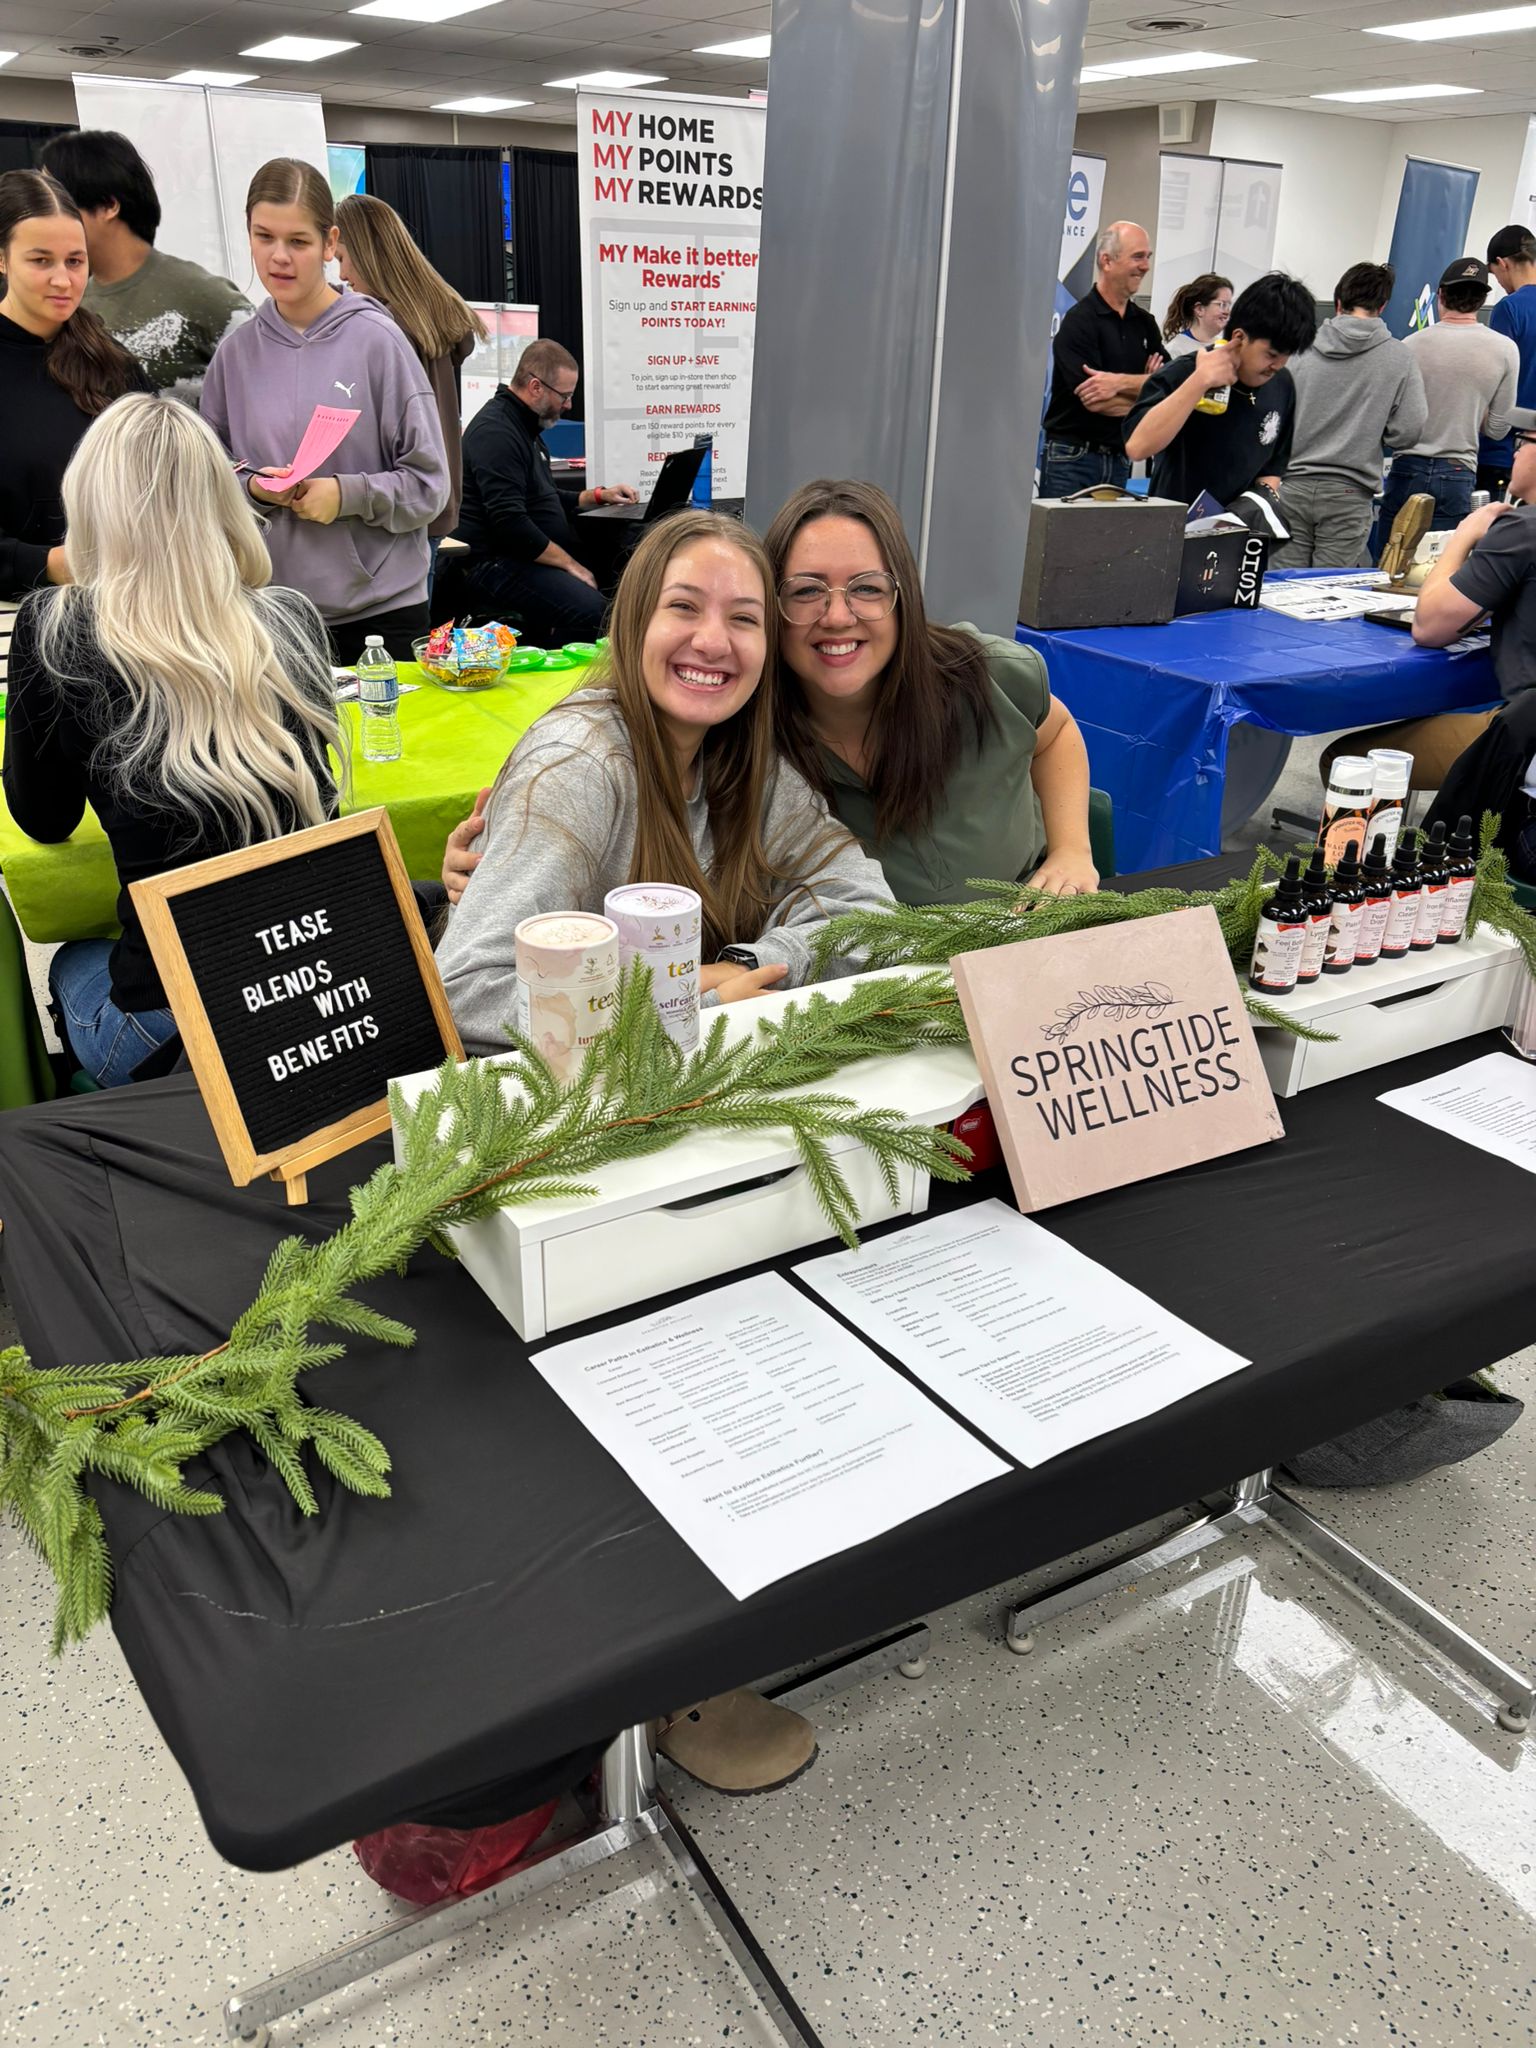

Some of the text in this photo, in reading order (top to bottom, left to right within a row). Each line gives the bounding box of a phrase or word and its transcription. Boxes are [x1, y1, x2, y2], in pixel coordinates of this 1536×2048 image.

[592, 109, 714, 144] MY HOME
[593, 143, 733, 177] MY POINTS
[594, 176, 763, 210] MY REWARDS
[600, 243, 758, 267] MY Make it better
[609, 300, 756, 315] Sign up and START EARNING
[641, 317, 726, 329] POINTS TODAY!
[647, 355, 671, 366] SIGN
[672, 355, 687, 366] UP
[695, 355, 720, 366] SAVE
[646, 404, 721, 415] EARN REWARDS
[255, 909, 333, 955] TEASE
[242, 959, 333, 1013] BLENDS
[313, 976, 371, 1018] WITH
[267, 1015, 379, 1081] BENEFITS
[1010, 1005, 1240, 1097] SPRINGTIDE
[1036, 1052, 1241, 1140] WELLNESS
[584, 1362, 607, 1371] Career
[608, 1355, 628, 1363] Paths
[637, 1341, 667, 1353] Esthetics
[674, 1328, 703, 1339] Wellness
[703, 1493, 723, 1503] Want
[732, 1478, 760, 1491] Explore
[761, 1463, 794, 1479] Esthetics
[794, 1449, 823, 1464] Further?
